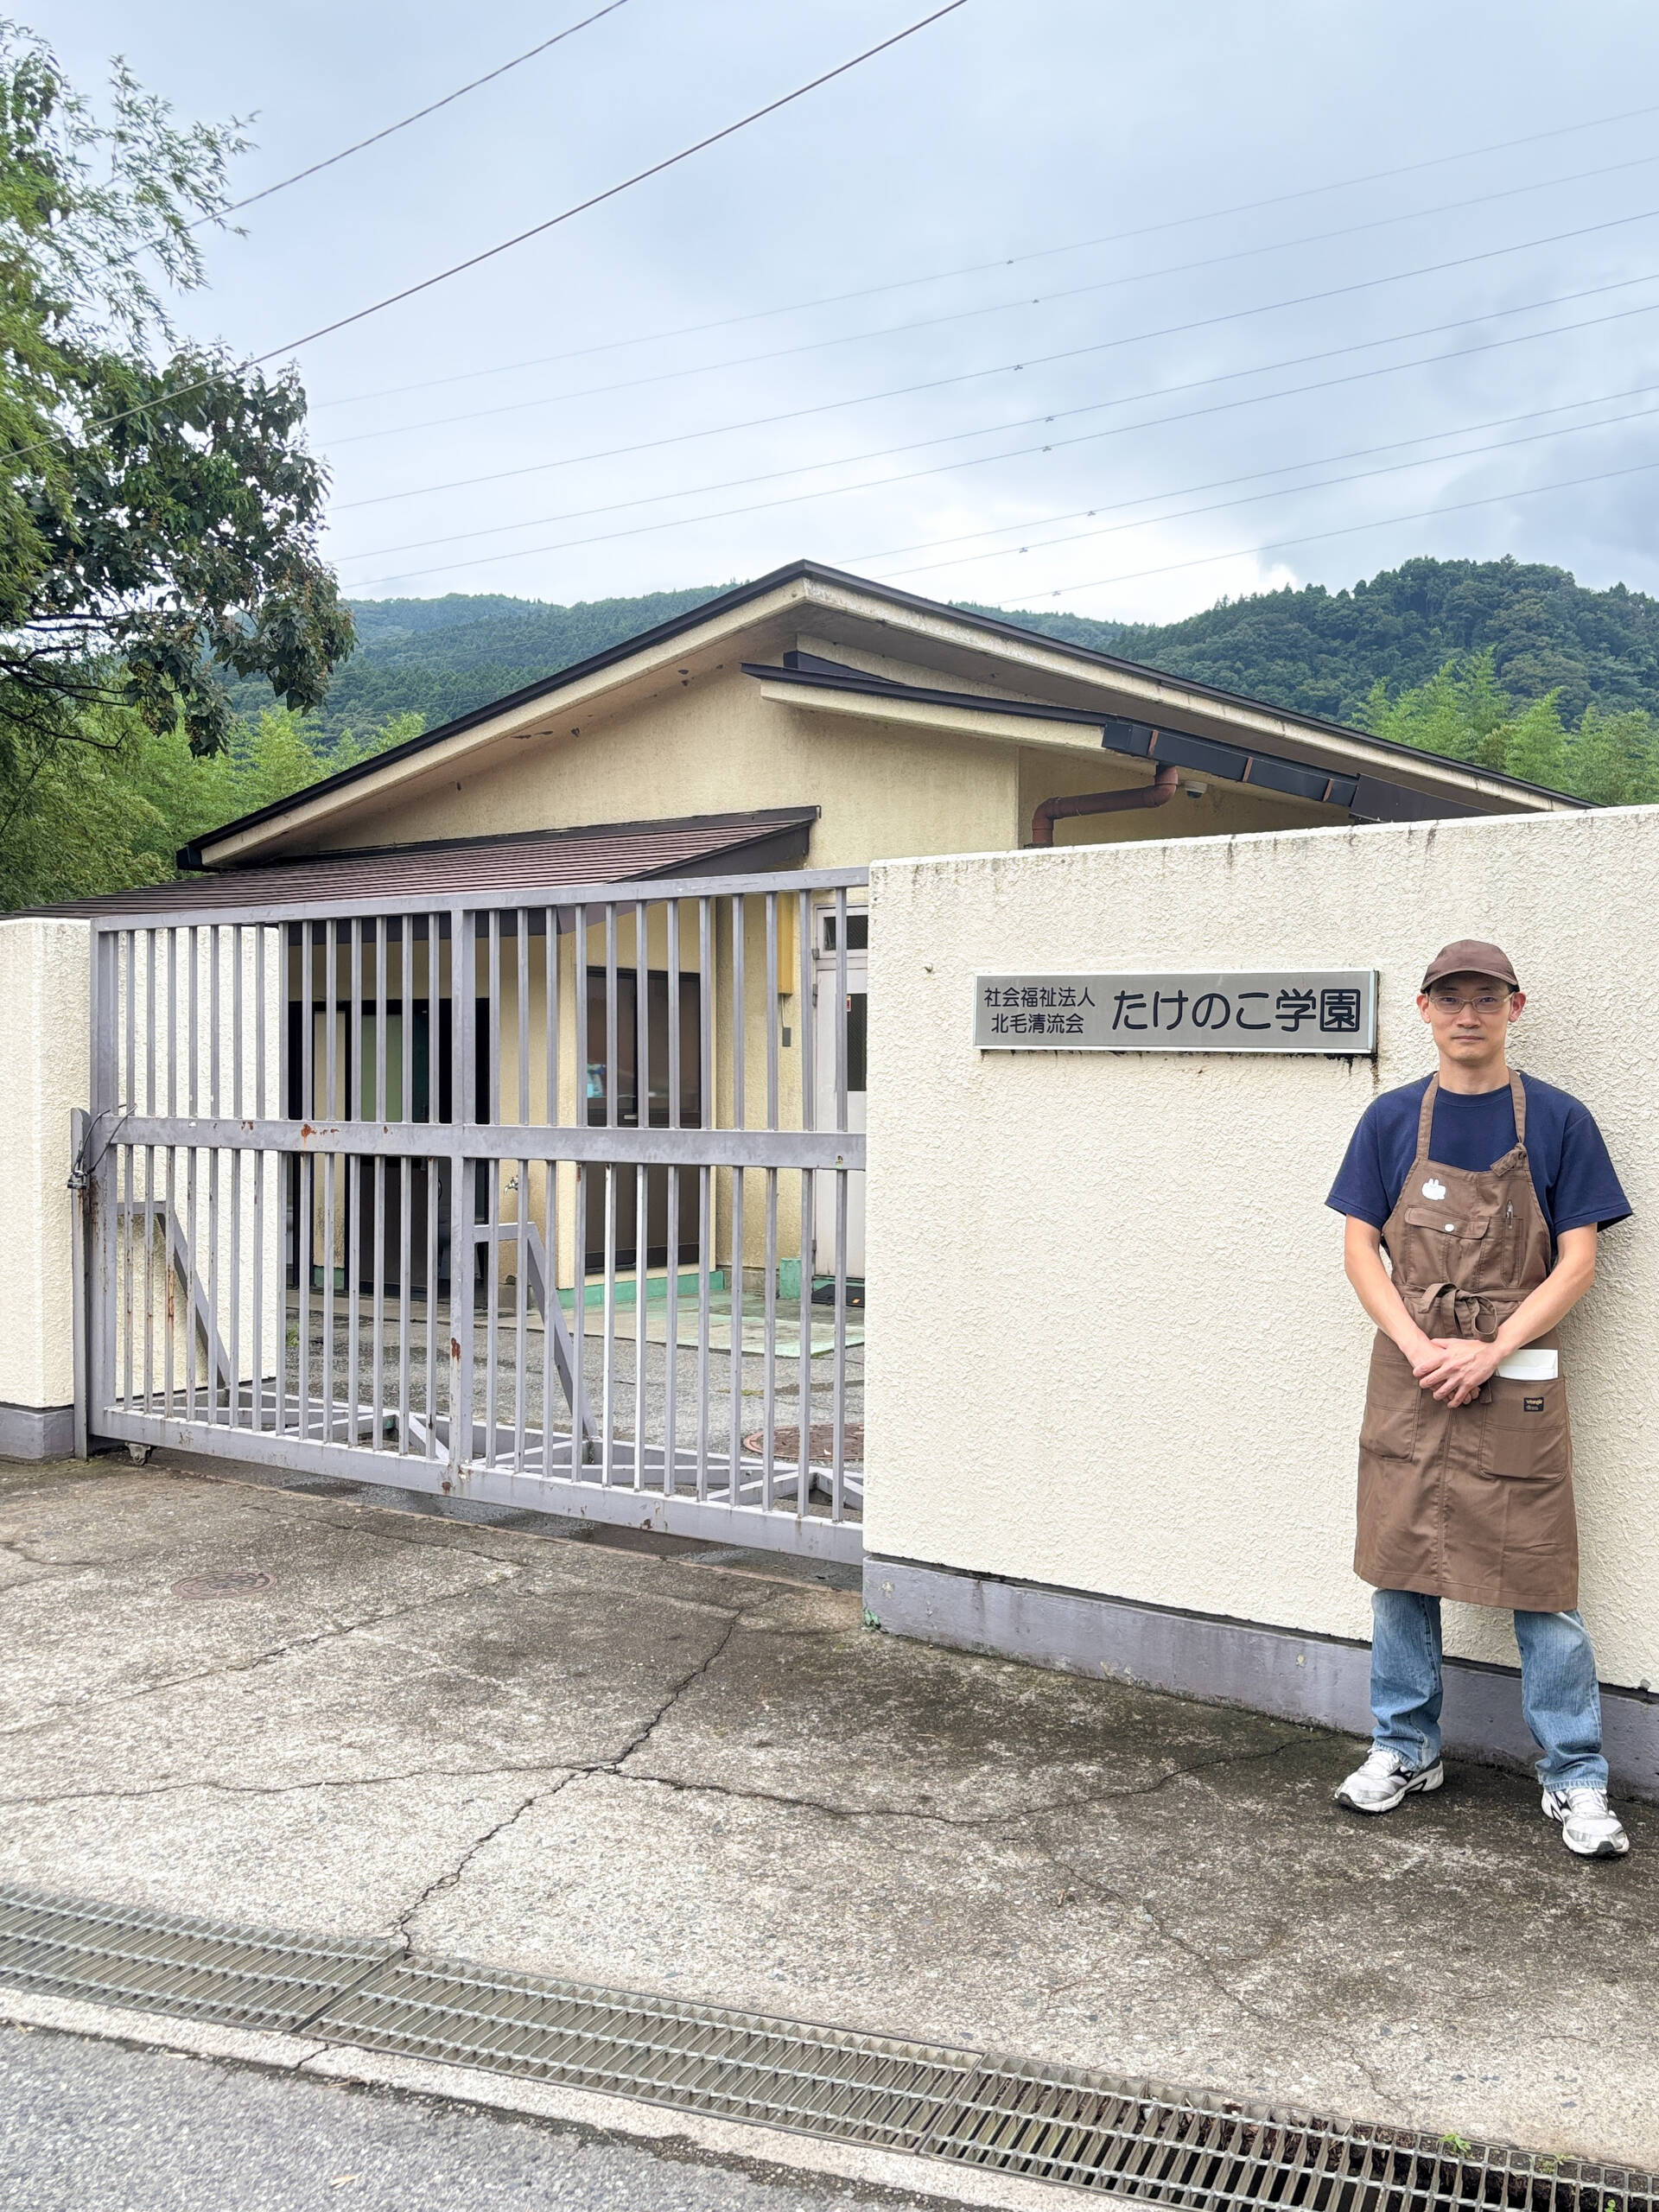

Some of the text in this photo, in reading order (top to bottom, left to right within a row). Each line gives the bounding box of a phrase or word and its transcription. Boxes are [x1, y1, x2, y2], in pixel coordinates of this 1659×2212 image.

[983, 986, 1096, 1008] 社会福祉法人
[1111, 988, 1361, 1033] たけのこ学園
[991, 1013, 1084, 1034] 北毛清流会
